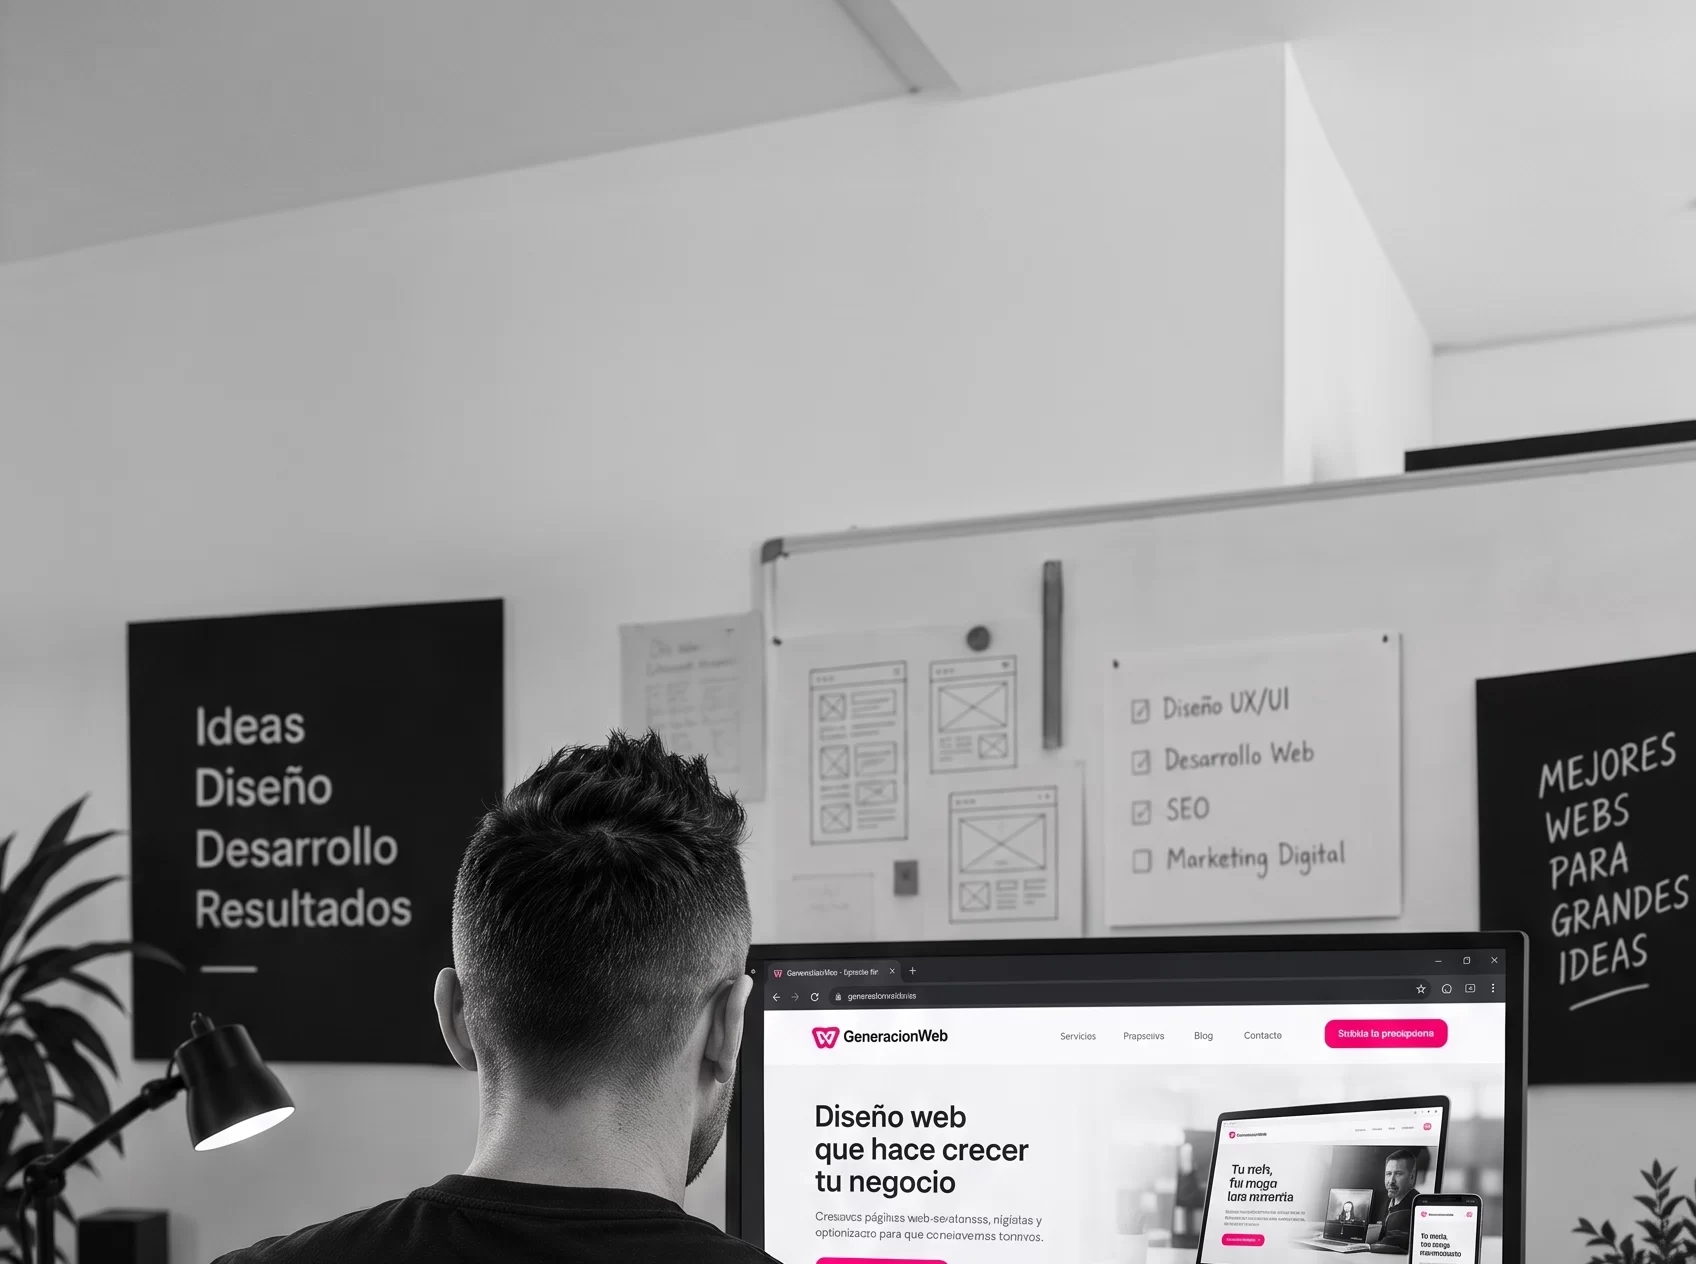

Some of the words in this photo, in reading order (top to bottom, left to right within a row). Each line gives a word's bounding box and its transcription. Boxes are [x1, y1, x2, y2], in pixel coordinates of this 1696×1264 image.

[1163, 695, 1223, 721] Diseño
[1230, 686, 1290, 717] UX/UI
[196, 705, 306, 746] Ideas
[1164, 744, 1263, 772] Desarrollo
[1270, 739, 1316, 765] Web
[1538, 730, 1678, 800] MEJORES
[196, 766, 334, 808] Diseño
[1166, 796, 1211, 822] SEO
[1544, 791, 1631, 844] WEBS
[196, 826, 399, 869] Desarrollo
[1166, 846, 1269, 879] Marketing
[1278, 840, 1347, 877] Digital
[1548, 840, 1630, 891] PARA
[196, 887, 413, 929] Resultados
[1550, 874, 1691, 938] GRANDES
[1558, 932, 1650, 986] IDEAS
[843, 1028, 949, 1045] GeneracionWeb
[1193, 1030, 1214, 1042] Blog
[1243, 1030, 1283, 1041] Contacto
[814, 1103, 904, 1129] Diseño
[910, 1104, 967, 1129] web
[814, 1140, 865, 1166] que
[871, 1137, 935, 1162] hace
[942, 1142, 1030, 1163] crecer
[814, 1171, 842, 1194] tu
[848, 1169, 957, 1200] negocio
[1231, 1164, 1245, 1175] Tu
[878, 1230, 902, 1242] para
[903, 1230, 924, 1242] que
[1035, 1216, 1043, 1228] y
